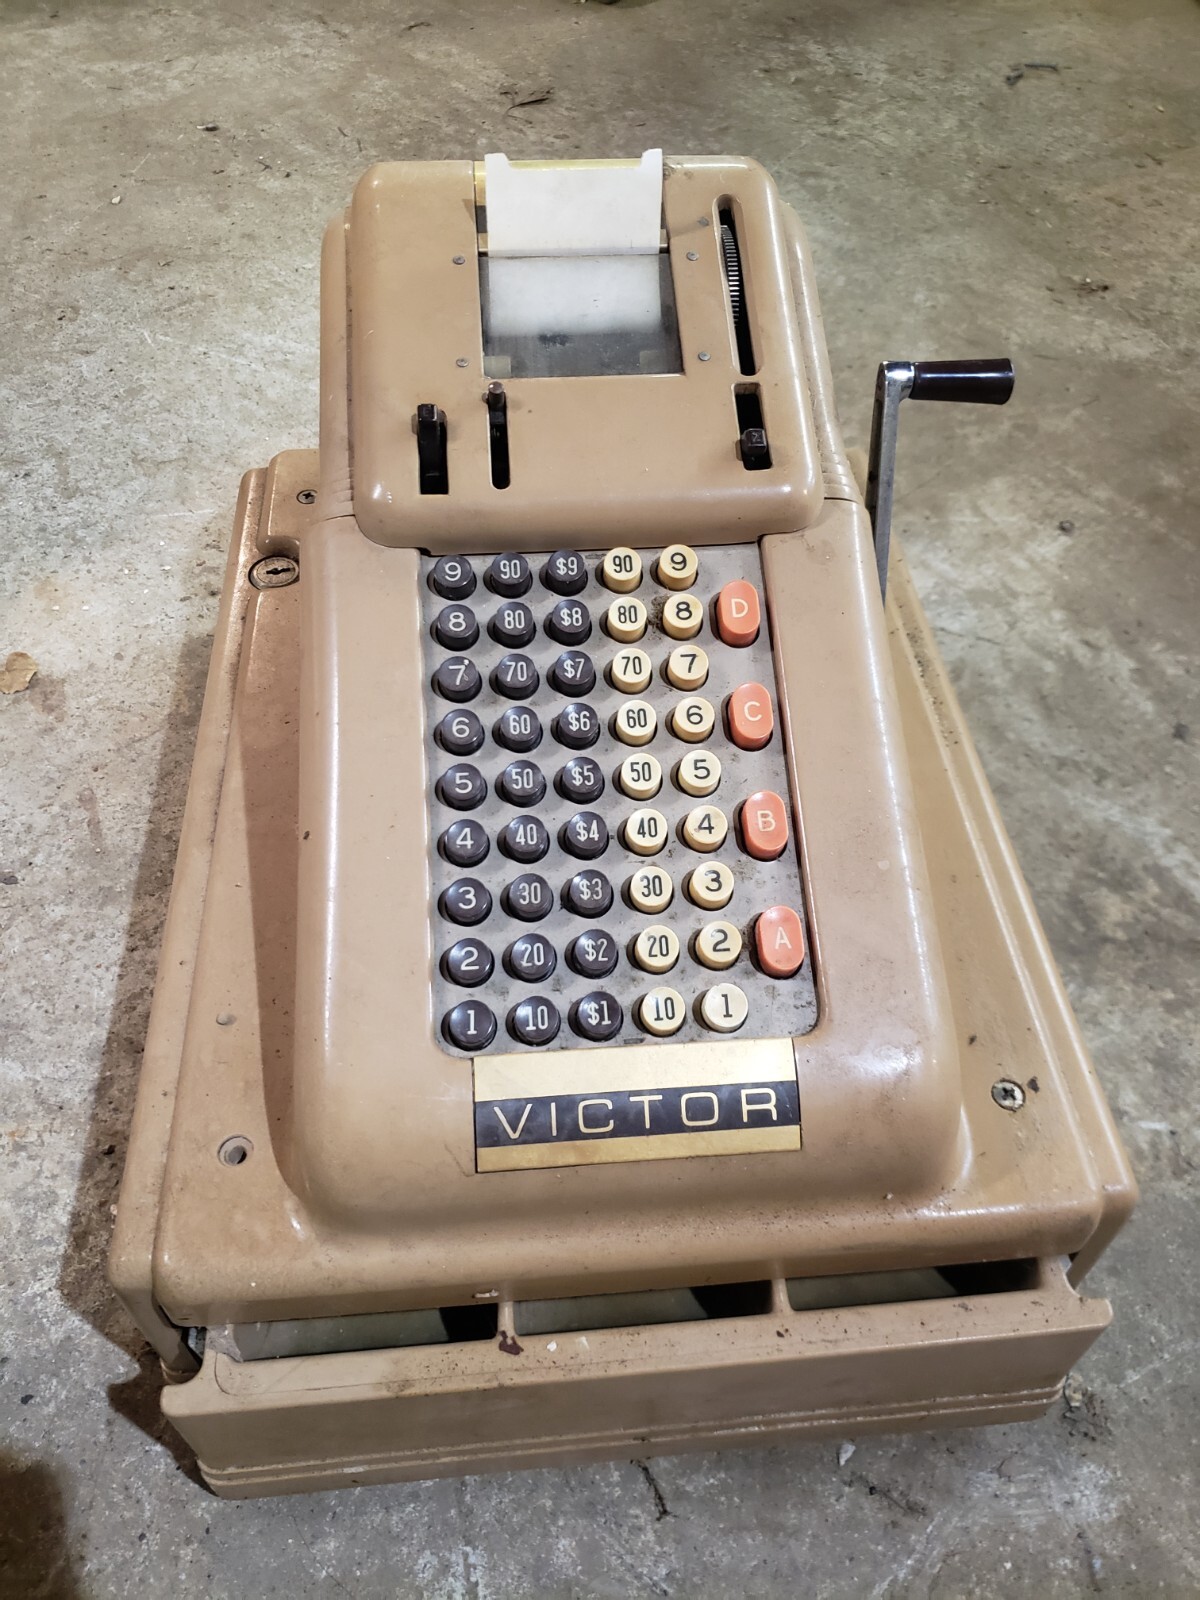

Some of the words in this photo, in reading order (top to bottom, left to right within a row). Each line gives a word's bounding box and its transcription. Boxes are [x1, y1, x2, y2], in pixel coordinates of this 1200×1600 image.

[444, 562, 462, 581] 9
[500, 559, 521, 579] 90
[556, 556, 578, 576] $9
[613, 554, 633, 574] 90
[670, 552, 687, 571] 9
[503, 609, 525, 629] 80
[560, 607, 583, 627] $8
[617, 605, 638, 624] 80
[675, 601, 693, 621] 8
[730, 598, 749, 618] D
[448, 612, 467, 632] 8
[448, 664, 466, 685] 7
[506, 661, 528, 682] 70
[563, 658, 585, 681] $7
[621, 656, 643, 676] 70
[680, 653, 697, 674] 7
[567, 710, 591, 732] $6
[626, 708, 648, 729] 60
[686, 705, 704, 725] 6
[744, 701, 762, 722] C
[452, 717, 470, 738] 6
[509, 714, 531, 735] 60
[511, 768, 534, 790] 50
[571, 765, 595, 787] $5
[630, 761, 652, 782] 50
[693, 759, 711, 780] 5
[454, 772, 473, 794] 5
[576, 819, 599, 842] $4
[637, 816, 658, 838] 40
[697, 813, 715, 835] 4
[756, 810, 776, 832] B
[455, 827, 474, 850] 4
[515, 823, 538, 846] 40
[579, 878, 603, 901] $3
[640, 875, 663, 898] 30
[704, 869, 723, 892] 3
[458, 886, 477, 910] 3
[518, 882, 541, 905] 30
[647, 934, 670, 958] 20
[710, 928, 731, 952] 2
[775, 926, 792, 950] A
[460, 946, 480, 971] 2
[520, 942, 545, 967] 20
[584, 938, 609, 962] $2
[587, 1000, 612, 1026] $1
[654, 996, 676, 1021] 10
[721, 993, 733, 1018] 1
[466, 1009, 478, 1035] 1
[525, 1005, 549, 1031] 10
[493, 1087, 778, 1140] VICTOR
